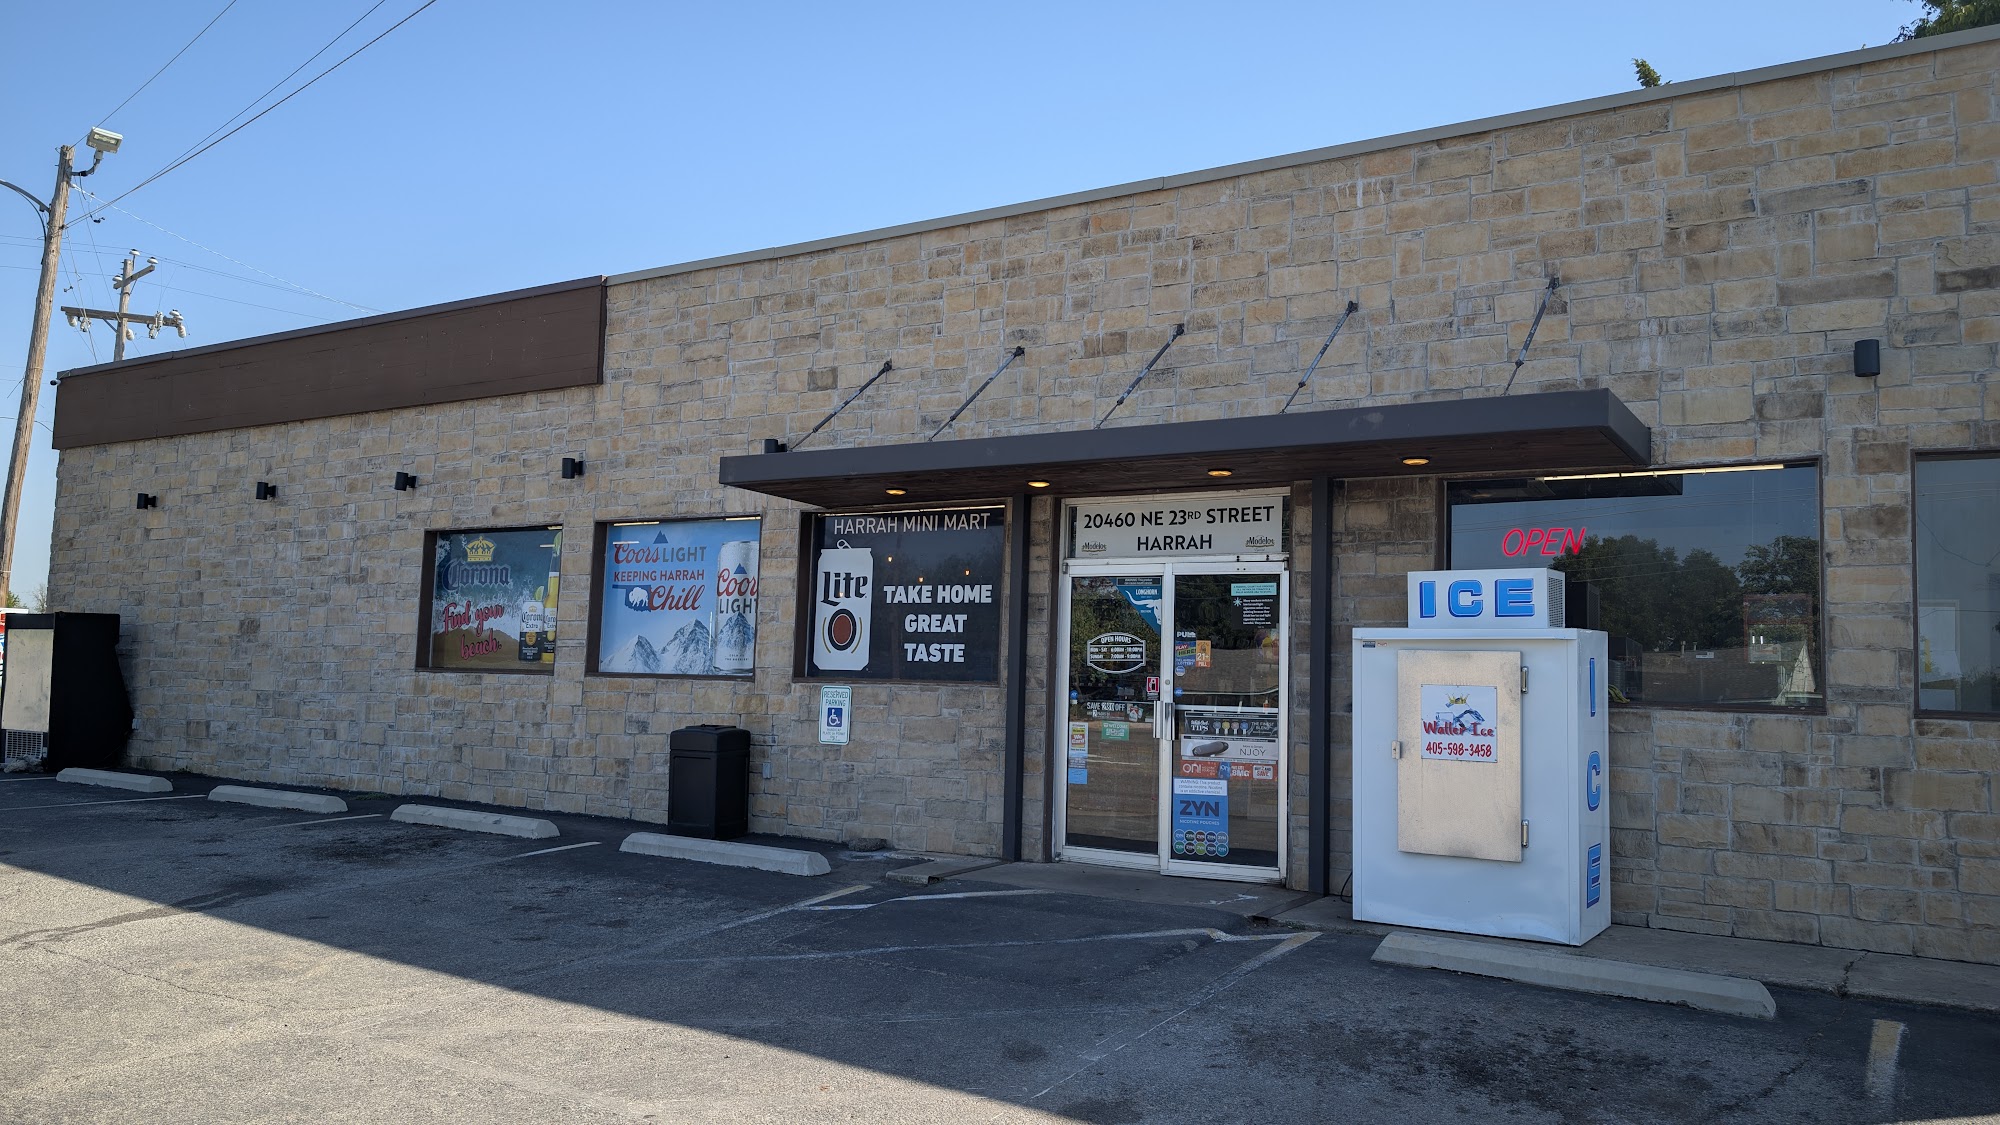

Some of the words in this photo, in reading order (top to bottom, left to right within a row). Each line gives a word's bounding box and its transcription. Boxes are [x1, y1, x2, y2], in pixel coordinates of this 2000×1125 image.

[834, 517, 897, 534] HARRAH
[903, 515, 938, 532] MINI
[944, 513, 990, 531] MART
[1084, 512, 1135, 528] 20460
[1141, 511, 1164, 526] NE
[1169, 509, 1202, 525] 23RD
[1206, 505, 1275, 524] STREET
[1137, 534, 1213, 551] HARRAH
[1502, 527, 1587, 557] OPEN
[614, 543, 660, 565] Coors
[662, 546, 707, 563] LIGHT
[442, 558, 513, 592] Corona
[613, 571, 657, 582] KEEPING
[660, 569, 705, 581] HARRAH
[651, 584, 706, 611] Chill
[820, 571, 868, 607] Lite
[883, 585, 933, 604] TAKE
[937, 584, 993, 604] HOME
[1419, 578, 1535, 618] ICE
[443, 600, 471, 635] Find
[475, 603, 505, 637] your
[904, 614, 968, 633] GREAT
[1100, 636, 1114, 644] OPEN
[1115, 635, 1132, 643] HOURS
[904, 643, 965, 662] TASTE
[1197, 652, 1210, 661] 21+
[824, 690, 848, 699] RESERVED
[826, 699, 846, 707] PARKING
[1087, 702, 1100, 710] SAVE
[1423, 720, 1466, 736] Waller
[1470, 722, 1495, 737] Ice
[1240, 748, 1266, 756] NJOY
[1426, 742, 1492, 757] 405-598-3458
[1180, 800, 1220, 817] ZYN
